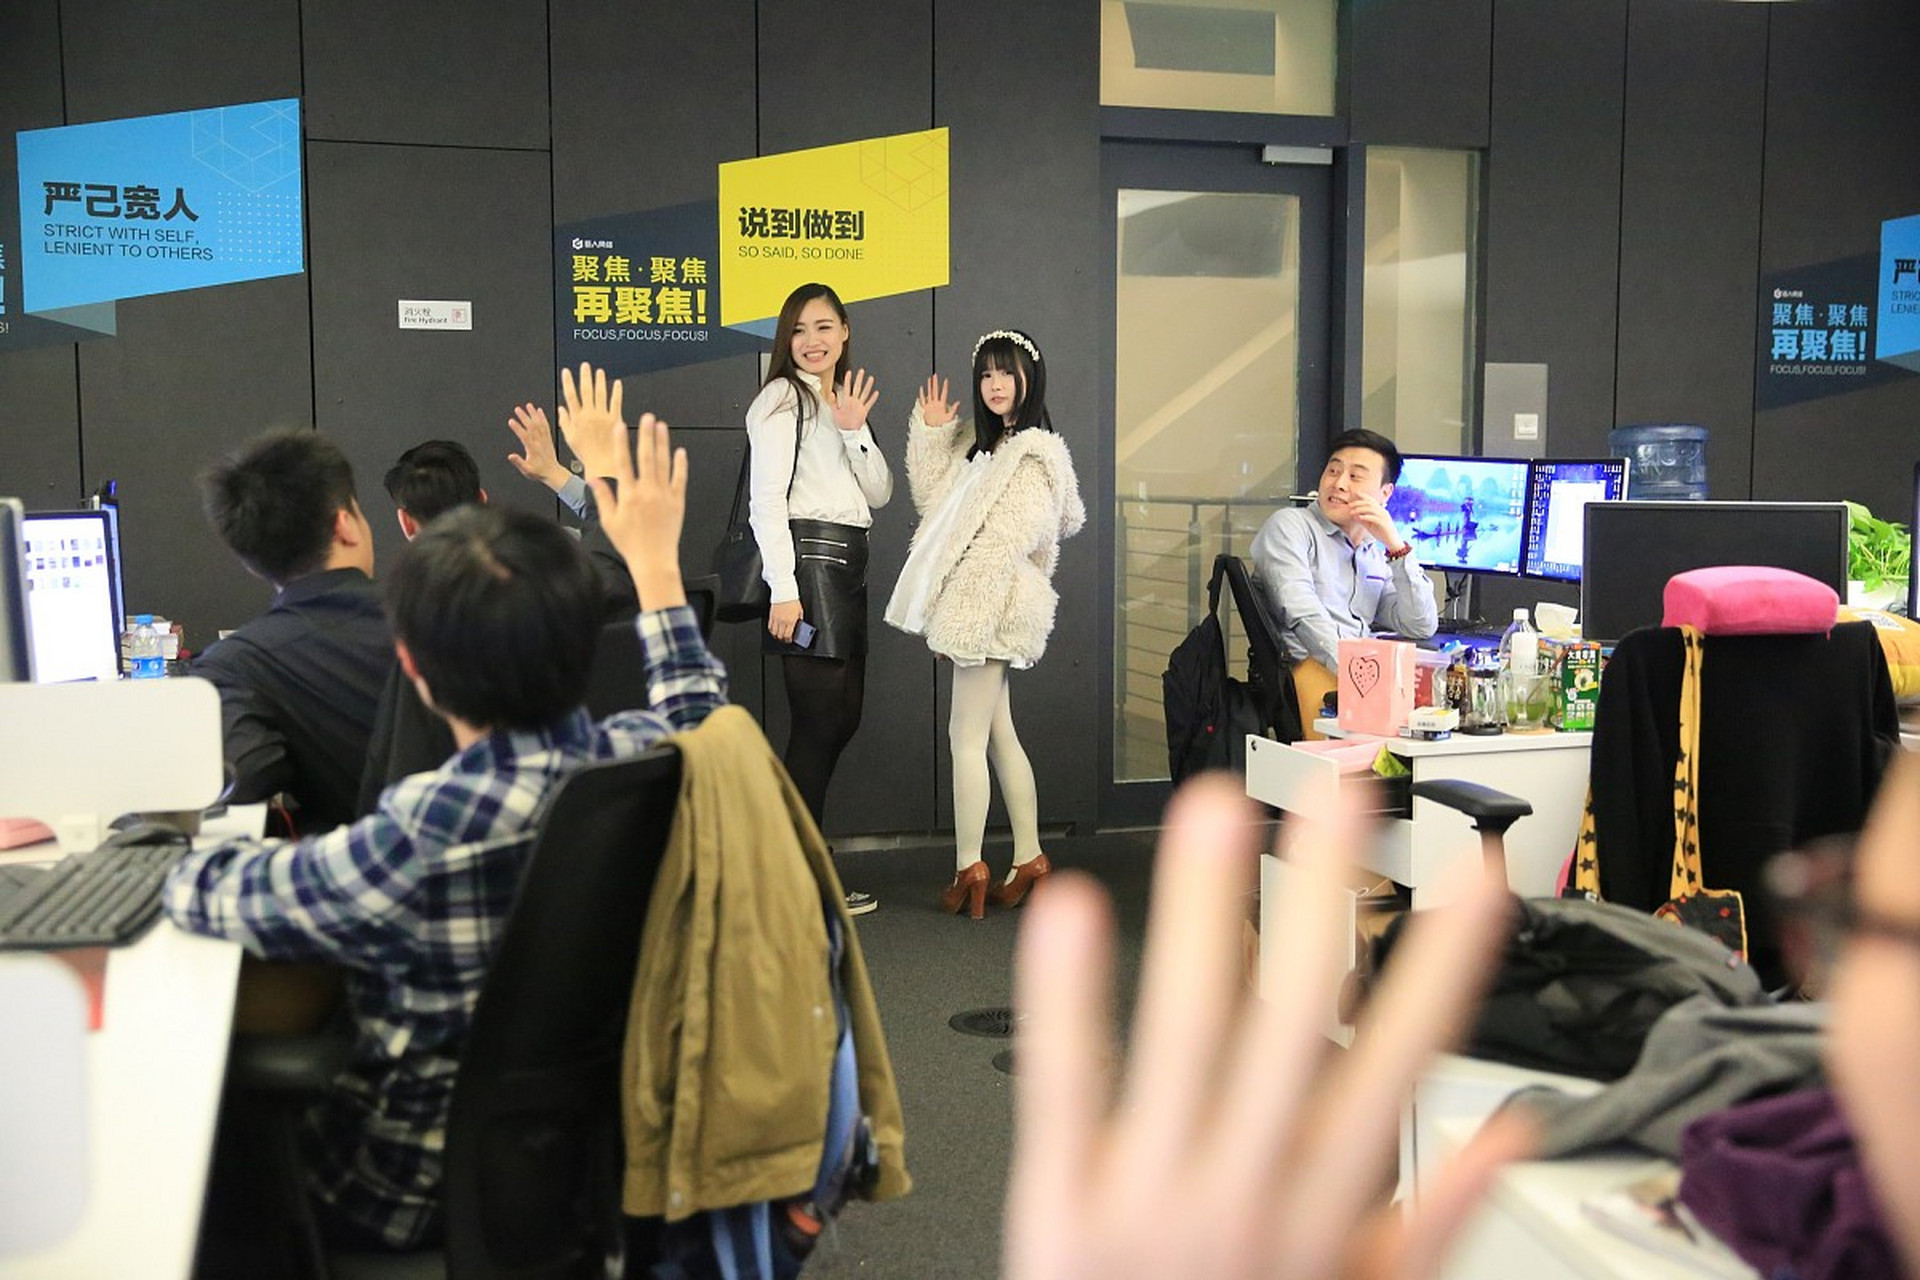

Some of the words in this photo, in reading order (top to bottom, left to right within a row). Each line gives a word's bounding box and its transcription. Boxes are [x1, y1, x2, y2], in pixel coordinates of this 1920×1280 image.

[43, 181, 199, 222] 严己宽人
[44, 223, 104, 239] STRICT
[108, 226, 150, 241] WITH
[154, 229, 200, 245] SELF,
[738, 207, 864, 240] 说到做到
[44, 241, 115, 256] LENIENT
[119, 244, 142, 257] TO
[146, 245, 214, 261] OTHERS
[738, 245, 759, 258] SO
[762, 245, 798, 260] SAID,
[801, 247, 822, 259] SO
[825, 248, 865, 260] DONE
[1893, 259, 1920, 285] 严
[573, 285, 707, 324] 再聚焦!
[1771, 329, 1867, 361] 再聚焦!
